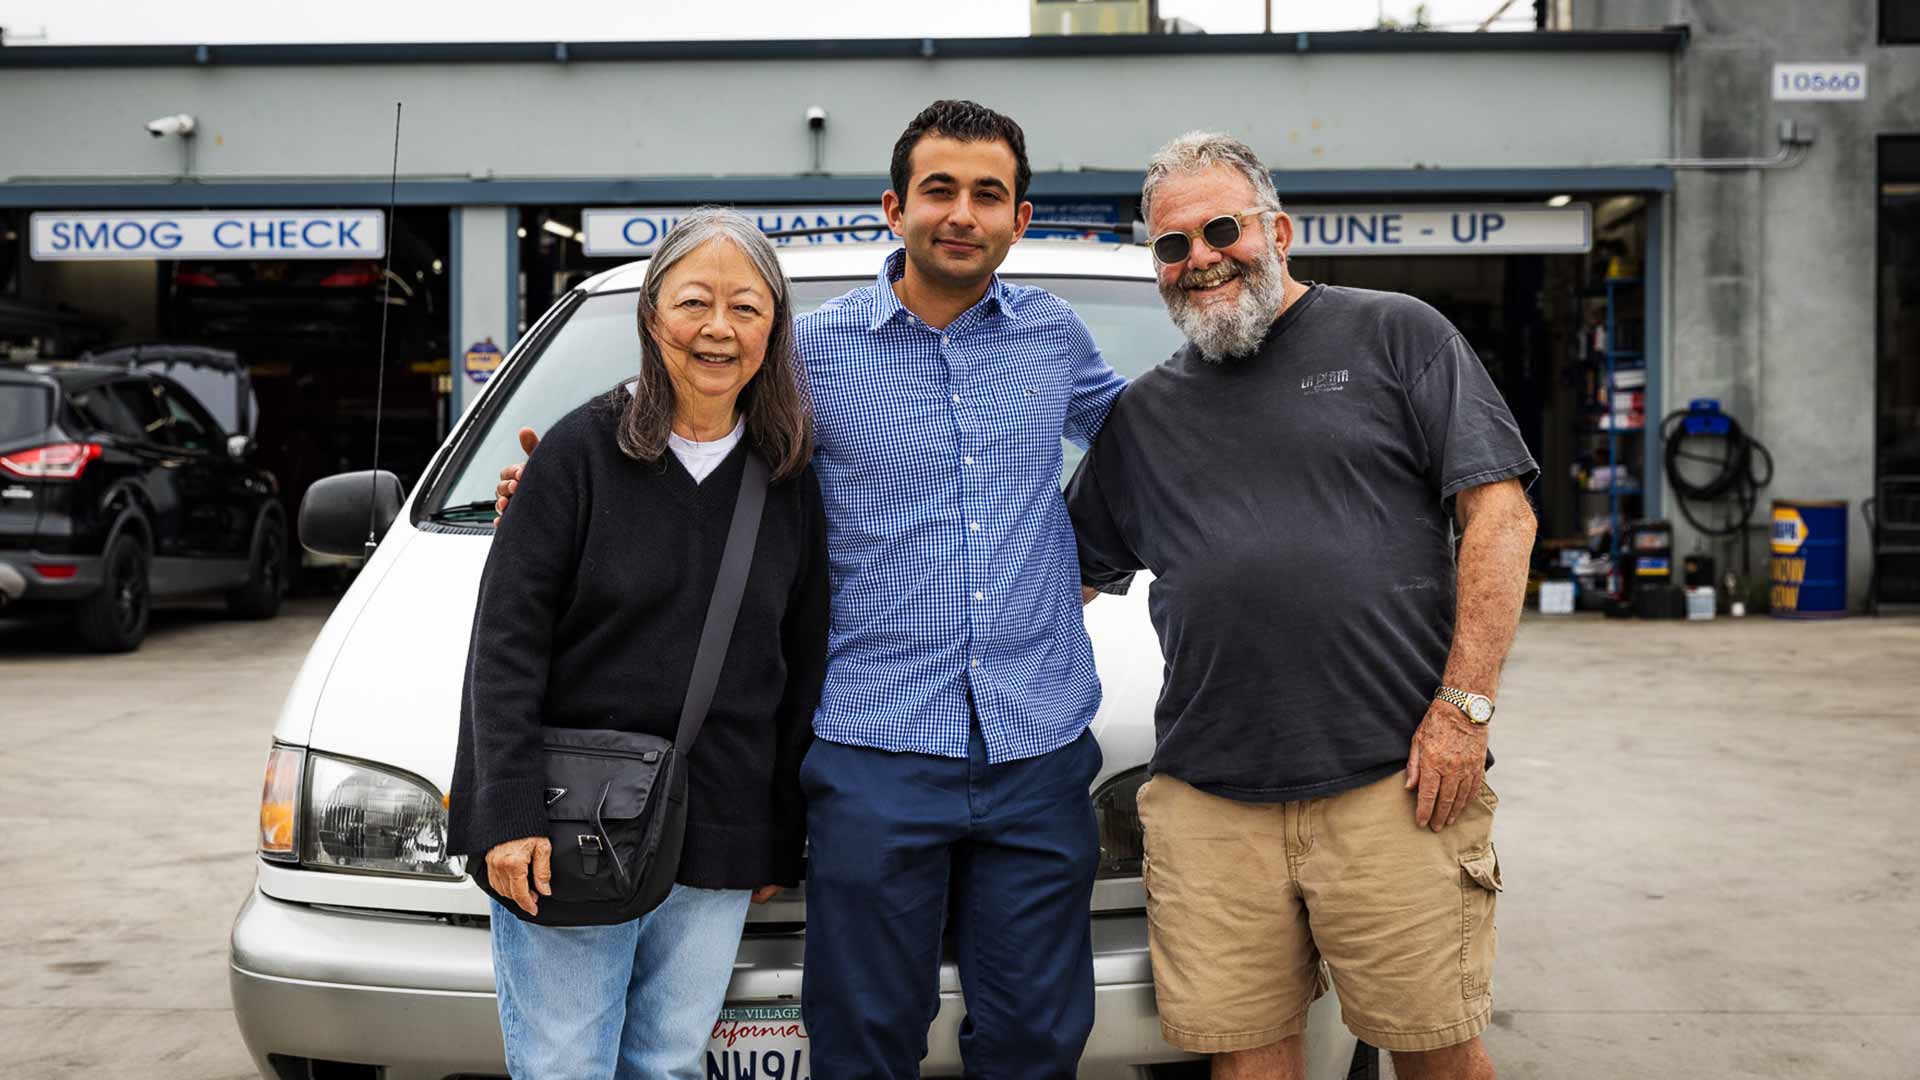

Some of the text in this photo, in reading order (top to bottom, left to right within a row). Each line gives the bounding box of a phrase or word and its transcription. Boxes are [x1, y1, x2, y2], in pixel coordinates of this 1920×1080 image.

[1781, 73, 1860, 92] 10560
[51, 220, 361, 250] SMOG CHECK
[623, 218, 678, 246] OI
[1298, 214, 1403, 245] TUNE
[1451, 212, 1505, 244] UP
[720, 1008, 800, 1020] HE VILLAGE
[710, 1020, 810, 1048] lifornia
